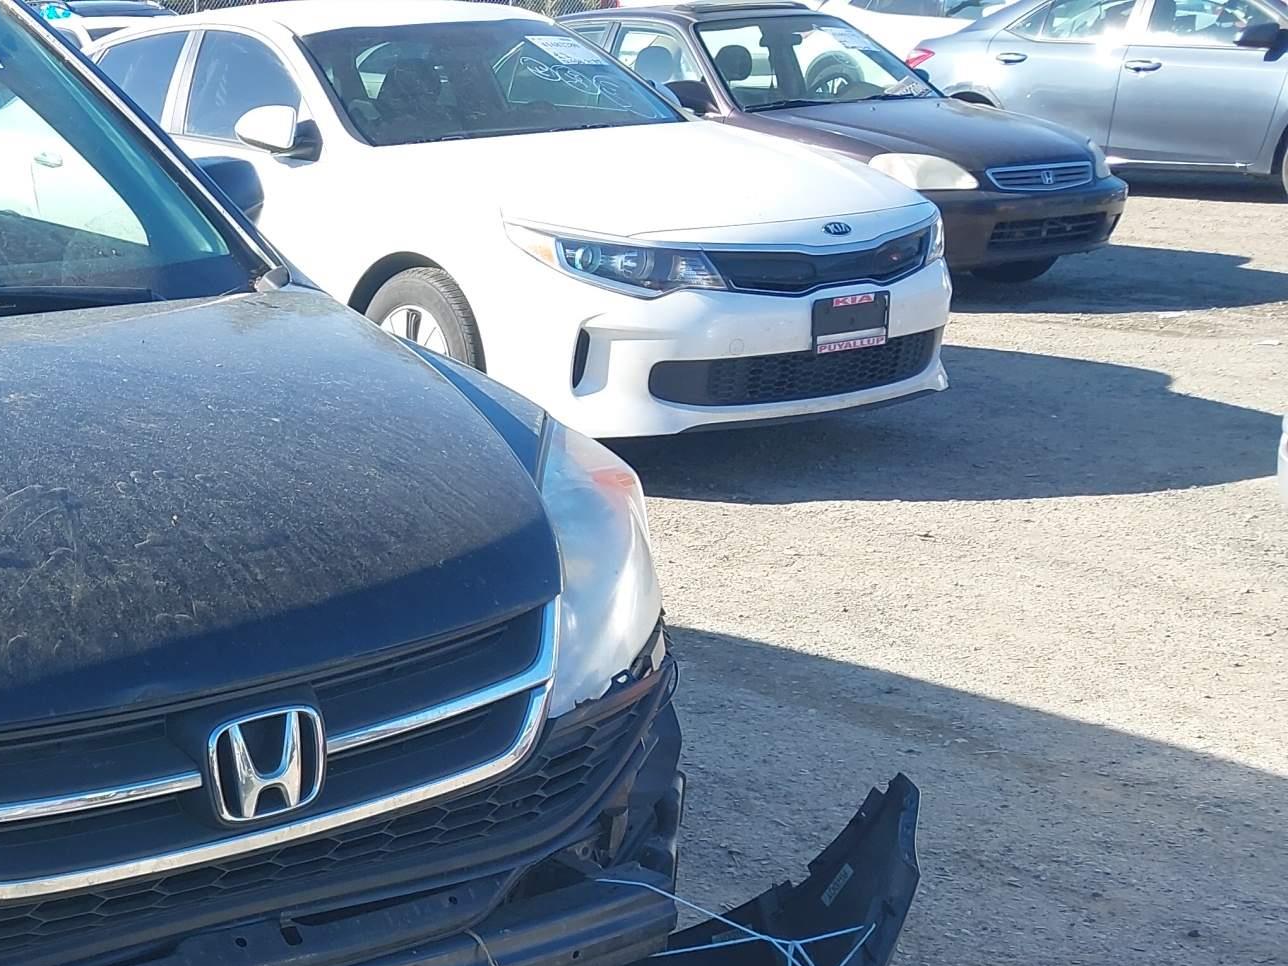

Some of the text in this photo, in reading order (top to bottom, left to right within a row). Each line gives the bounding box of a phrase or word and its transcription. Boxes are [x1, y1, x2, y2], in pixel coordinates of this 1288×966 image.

[826, 222, 851, 234] KIA
[833, 294, 873, 306] KIA
[818, 336, 885, 353] PUYALLUP
